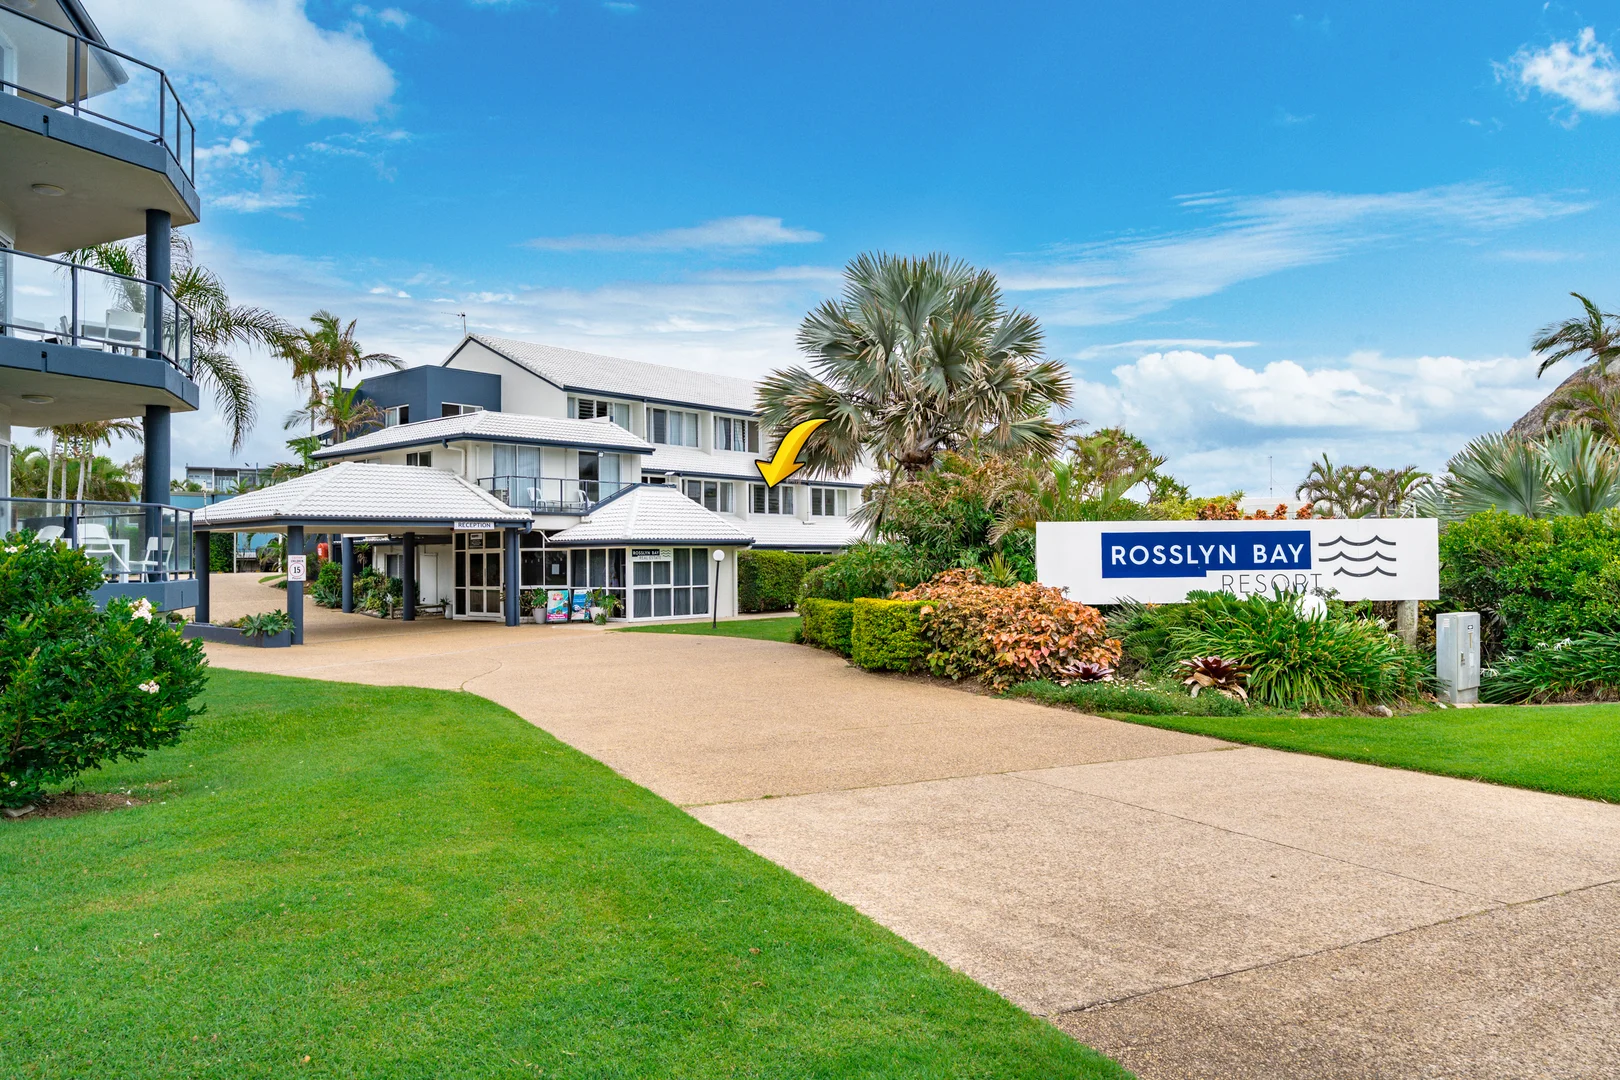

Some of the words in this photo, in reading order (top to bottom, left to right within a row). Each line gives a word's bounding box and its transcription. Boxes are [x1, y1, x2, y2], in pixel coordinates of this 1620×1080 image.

[1111, 544, 1236, 565] ROSSLYN
[1253, 543, 1304, 564] BAY
[1221, 573, 1323, 595] RESORT
